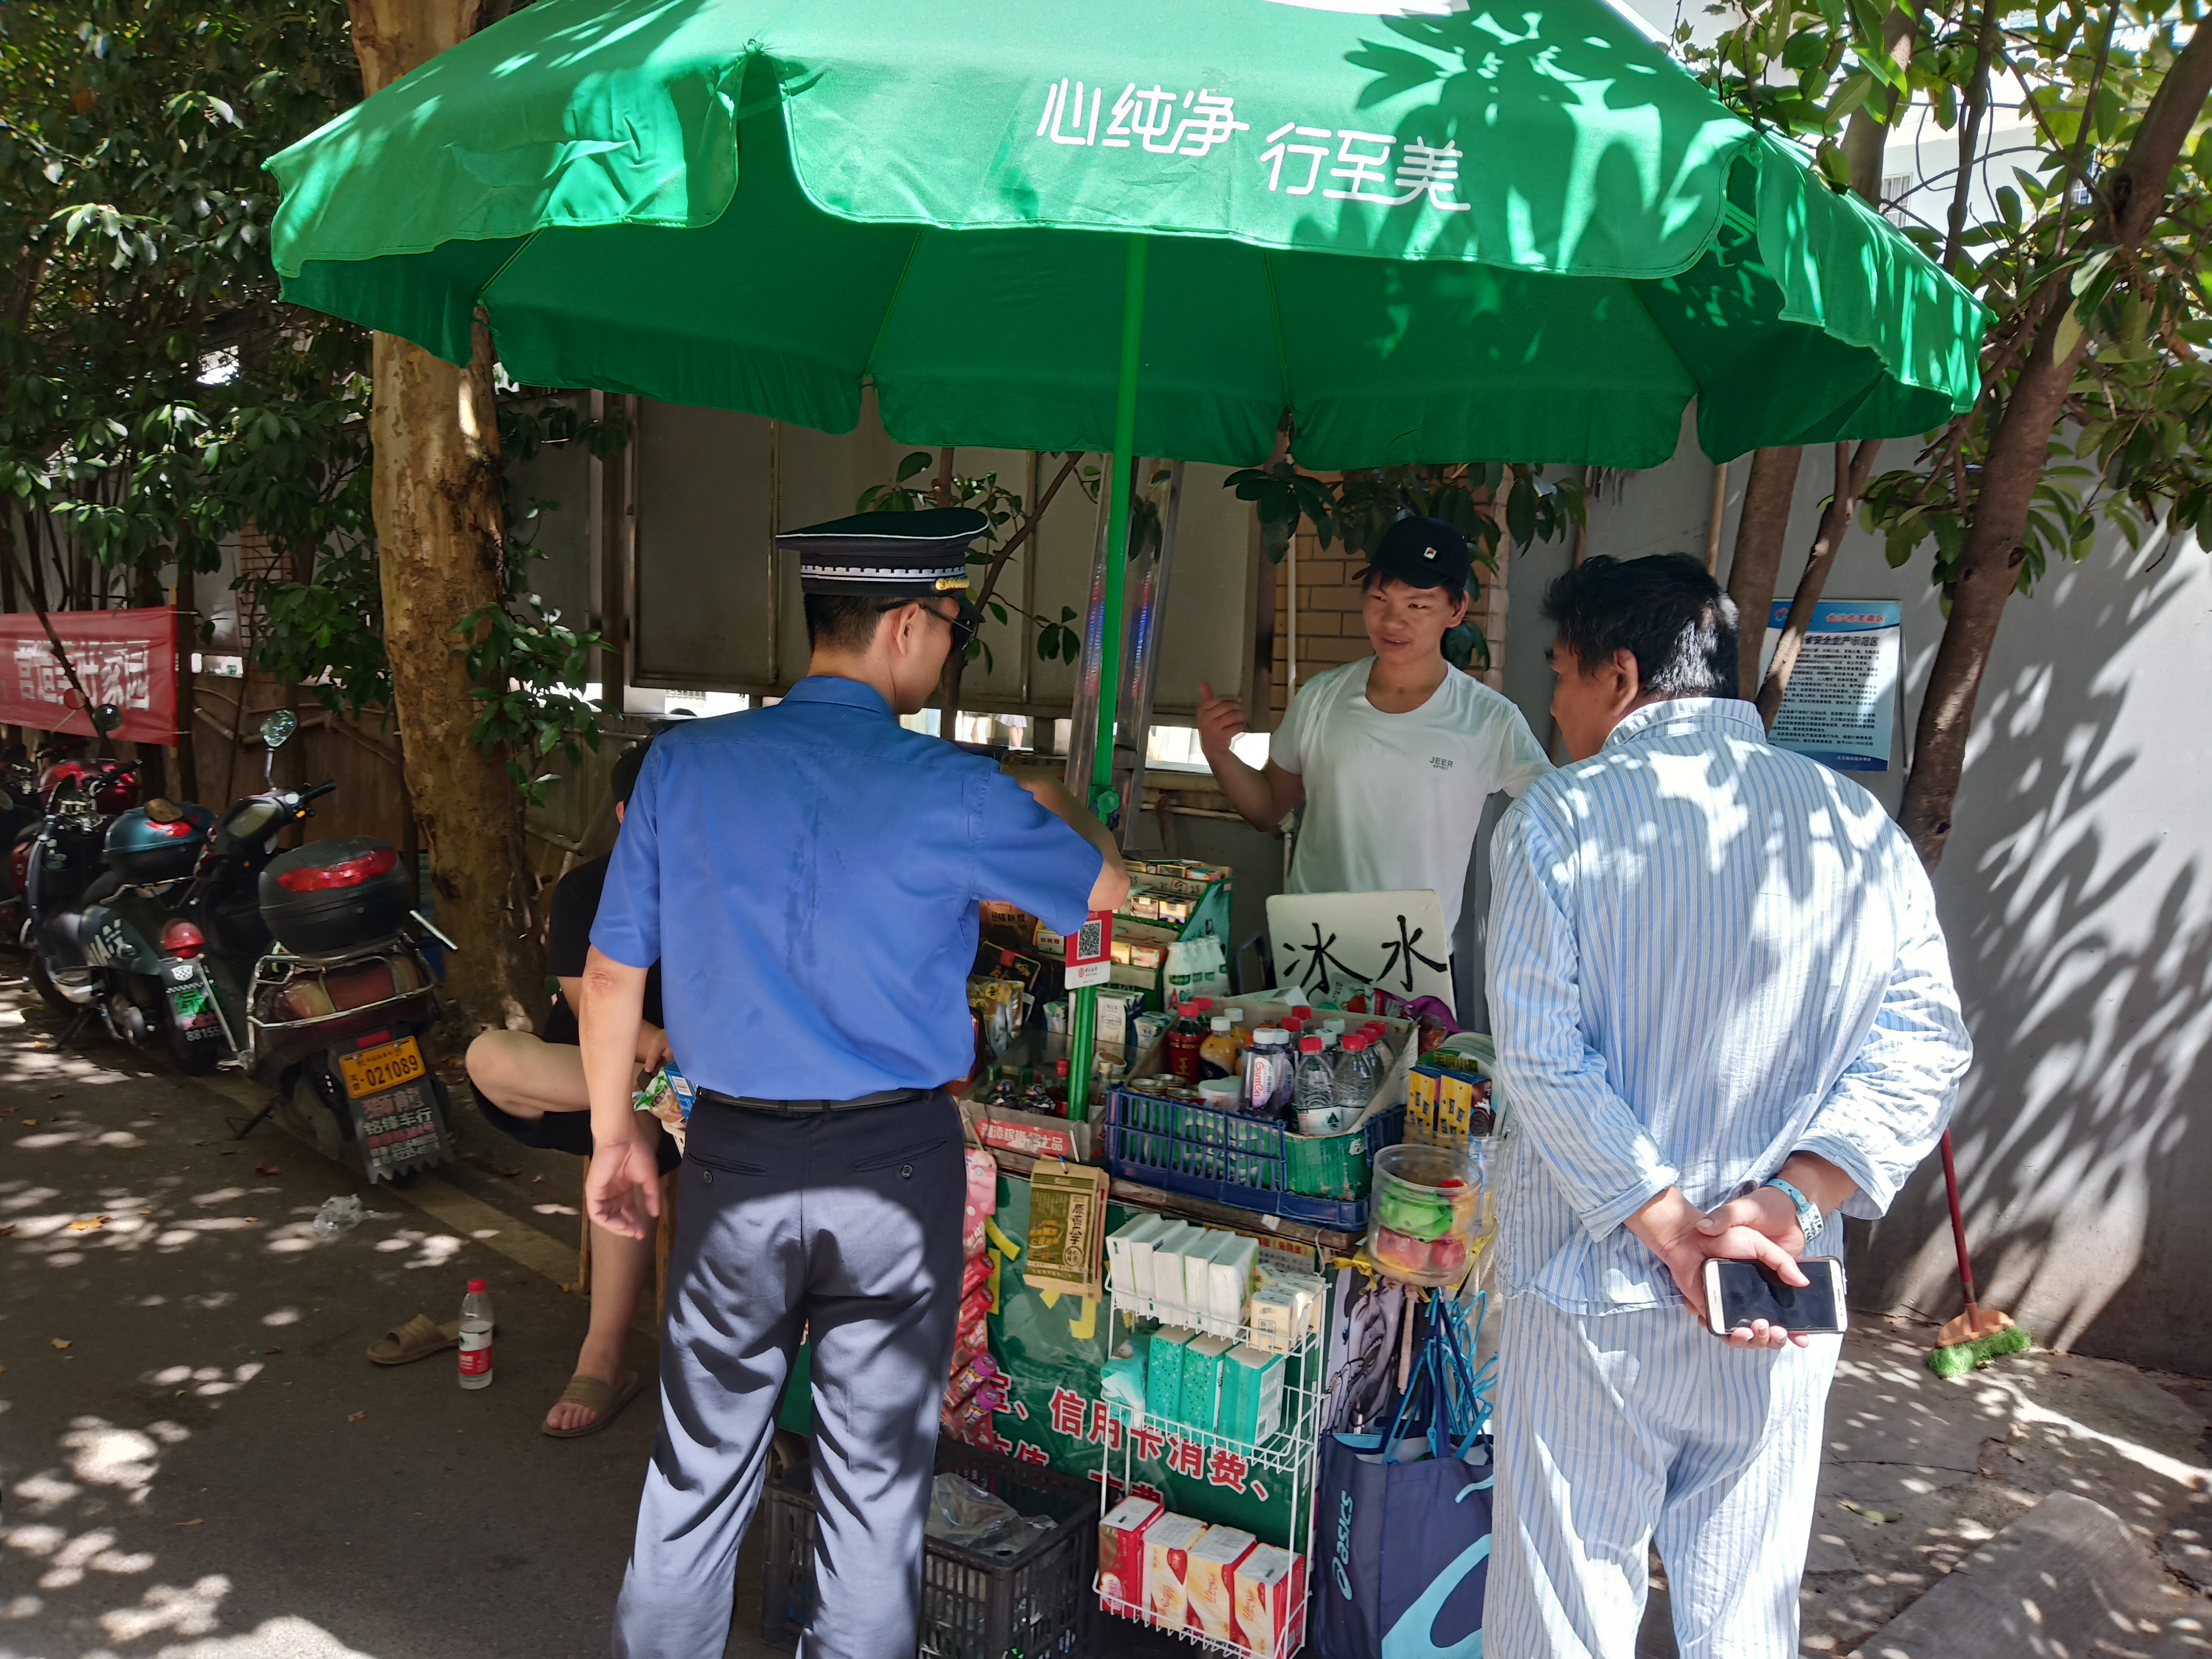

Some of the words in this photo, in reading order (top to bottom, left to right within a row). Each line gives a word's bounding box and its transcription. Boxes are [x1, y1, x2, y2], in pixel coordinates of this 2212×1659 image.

[1036, 77, 1250, 156] 心纯净
[1260, 121, 1471, 211] 行至美
[1430, 757, 1453, 768] JEER
[1283, 915, 1448, 1003] 冰水
[366, 1055, 419, 1086] 021089
